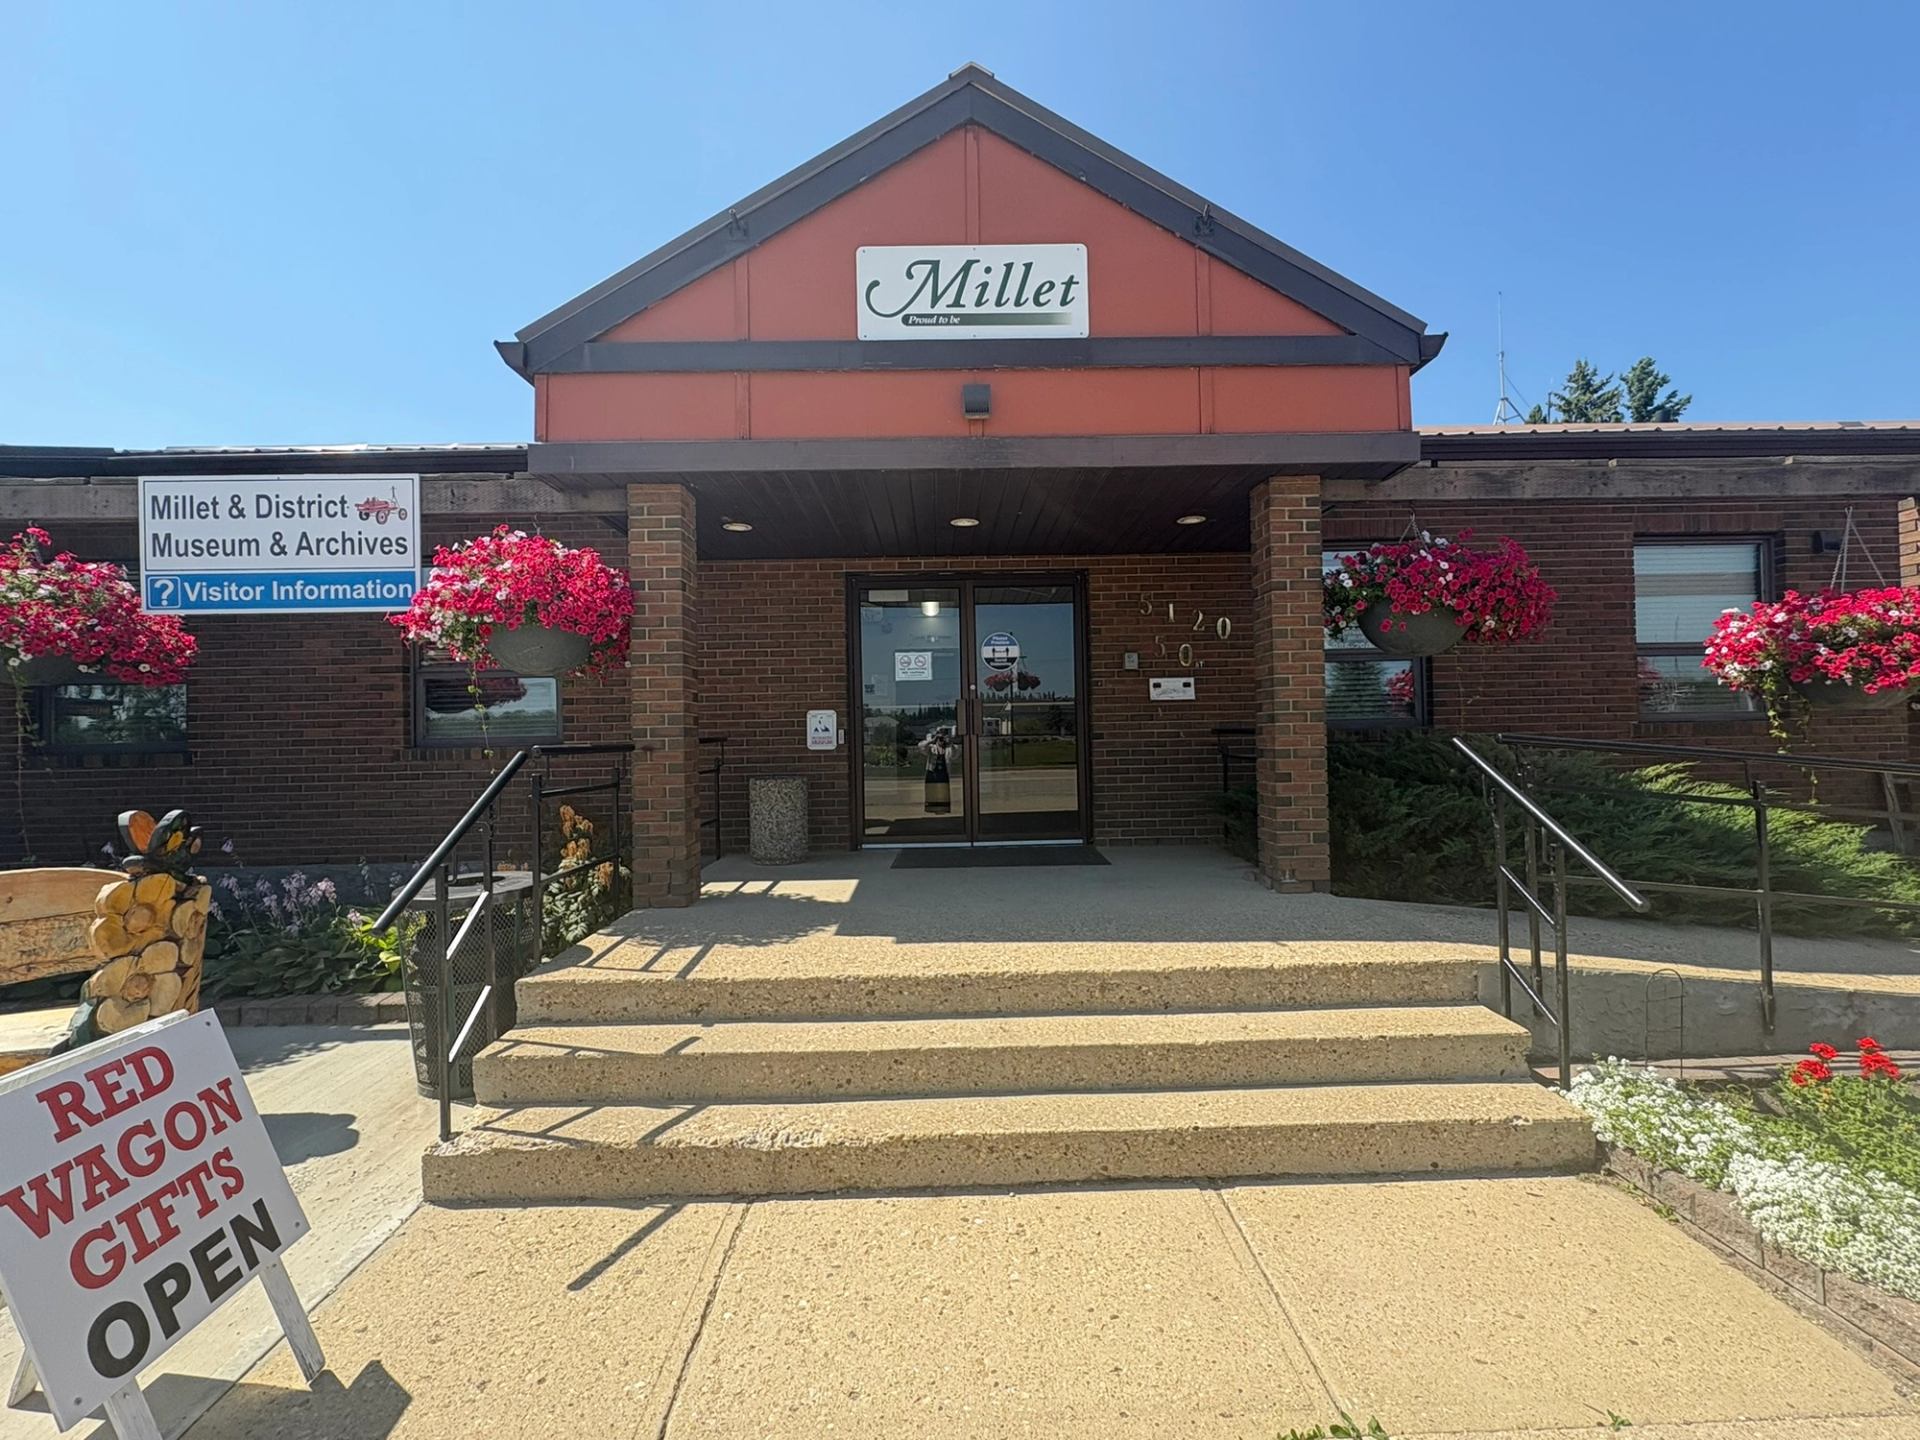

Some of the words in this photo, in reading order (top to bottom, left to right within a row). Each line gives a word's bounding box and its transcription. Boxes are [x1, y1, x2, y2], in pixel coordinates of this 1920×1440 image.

[865, 259, 1080, 318] Millet
[908, 315, 938, 324] Proud
[938, 316, 948, 324] to
[950, 315, 961, 324] be
[150, 495, 220, 520] Millet
[228, 494, 246, 519] &
[255, 493, 348, 519] District
[151, 532, 260, 558] Museum
[269, 531, 288, 557] &
[295, 530, 409, 557] Archives
[184, 580, 265, 603] Visitor
[272, 579, 412, 602] Information
[36, 1046, 175, 1143] RED
[0, 1077, 244, 1239] WAGON
[69, 1147, 245, 1290] GIFTS
[86, 1197, 283, 1379] OPEN
